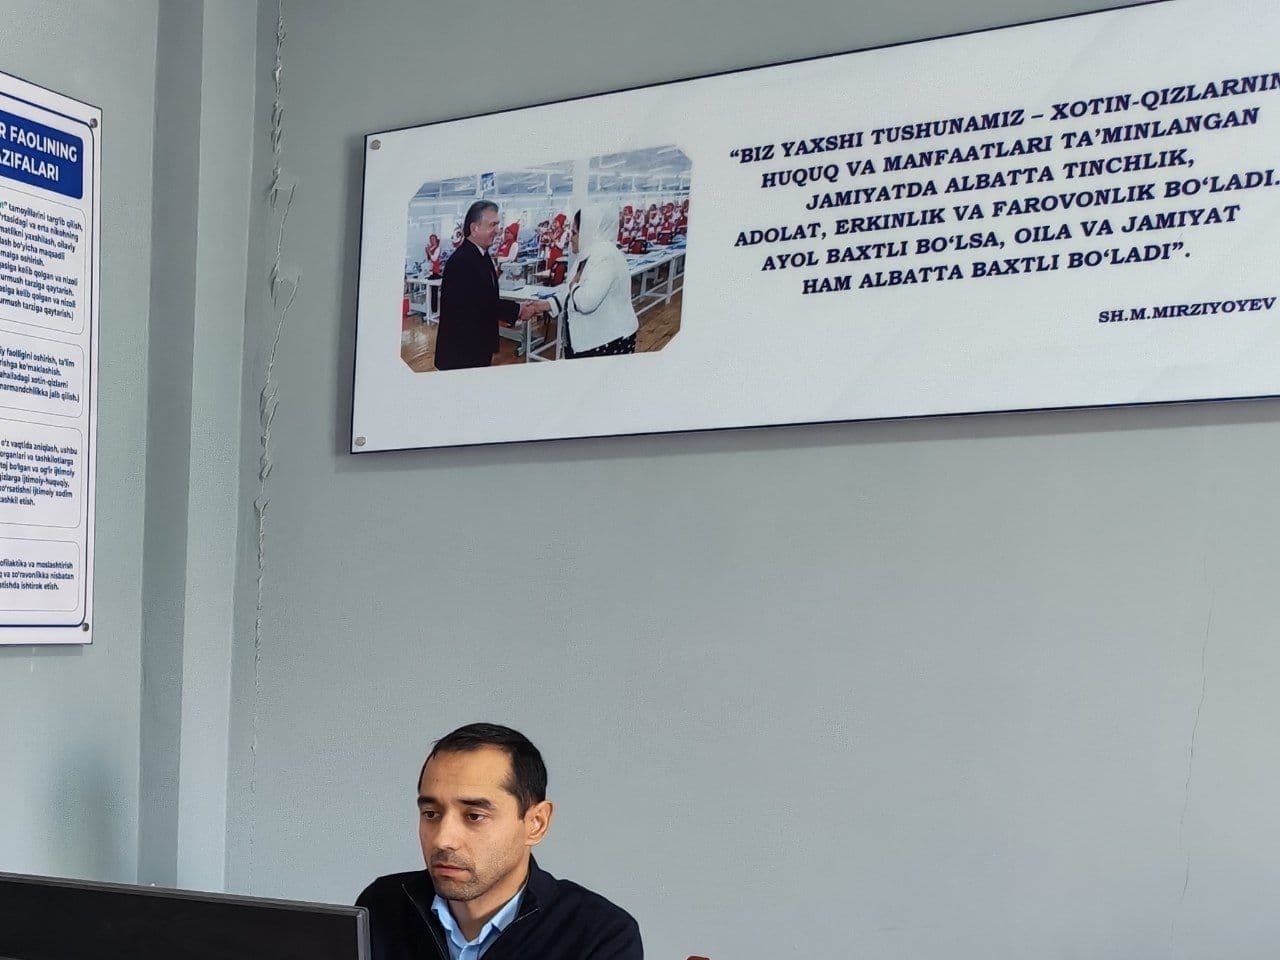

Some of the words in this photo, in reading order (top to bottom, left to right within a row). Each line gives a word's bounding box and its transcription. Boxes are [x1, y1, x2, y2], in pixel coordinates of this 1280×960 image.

[10, 127, 77, 162] FAOLINING
[730, 144, 774, 164] “BIZ
[782, 132, 864, 158] YAXSHI
[871, 110, 1024, 145] TUSHUNAMIZ
[761, 165, 839, 188] HUQUQ
[847, 160, 876, 177] VA
[883, 136, 1052, 172] MANFAATLARI
[1061, 108, 1260, 149] TA’MINLANGAN
[806, 180, 938, 210] JAMIYATDA
[945, 166, 1054, 194] ALBATTA
[1063, 149, 1194, 180] TINCHLIK,
[734, 223, 827, 246] ADOLAT,
[834, 208, 946, 235] ERKINLIK
[953, 204, 983, 221] VA
[992, 184, 1156, 217] FAROVONLIK
[762, 252, 819, 271] AYOL
[826, 241, 908, 264] BAXTLI
[916, 232, 1005, 254] BO‘LSA,
[1014, 224, 1072, 243] OILA
[1080, 220, 1113, 237] VA
[1121, 205, 1240, 232] JAMIYAT
[802, 276, 852, 294] HAM
[859, 264, 964, 289] ALBATTA
[971, 254, 1059, 278] BAXTLI
[1099, 297, 1276, 323] SH.M.MIRZIYOYEV
